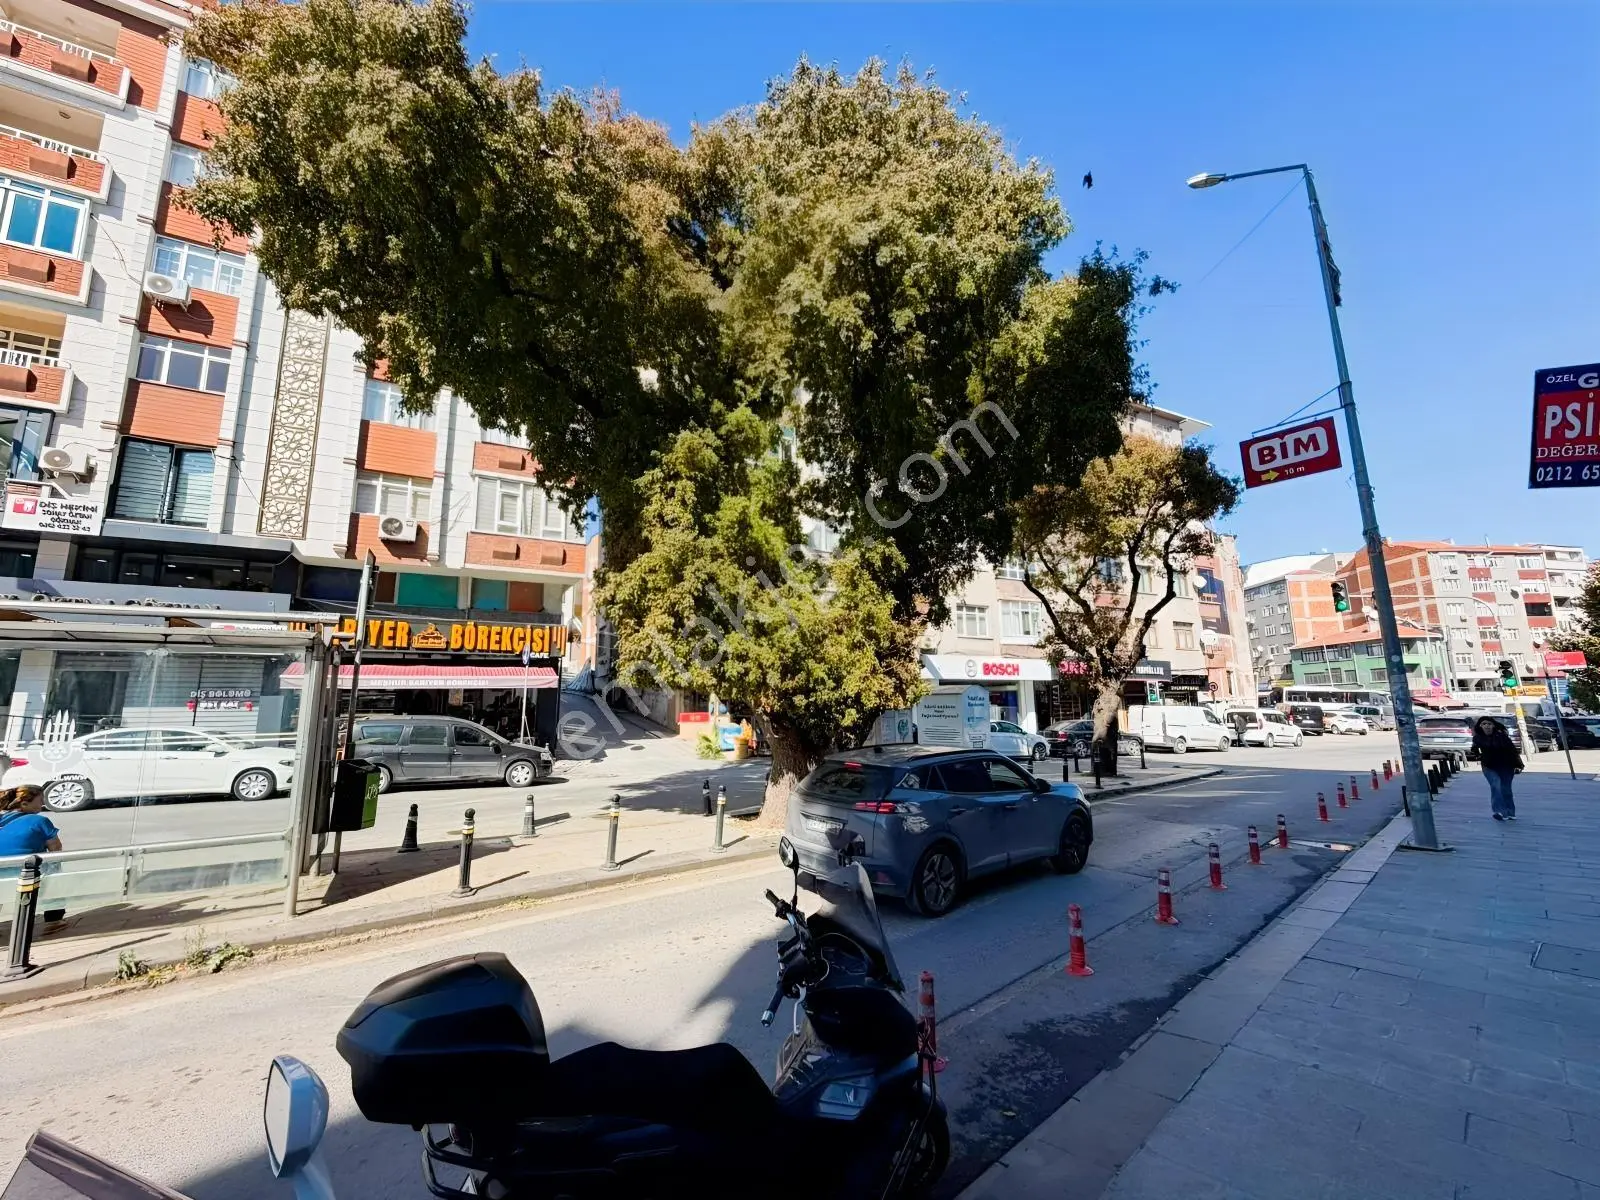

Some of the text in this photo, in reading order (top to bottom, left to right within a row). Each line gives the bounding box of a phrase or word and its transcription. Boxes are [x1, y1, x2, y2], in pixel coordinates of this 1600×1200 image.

[1546, 373, 1577, 383] ÖZEL
[1544, 391, 1600, 440] PSİ
[1284, 468, 1295, 476] 10
[1536, 465, 1573, 482] 0212
[450, 621, 550, 655] BÖREKÇİSİ
[983, 662, 1020, 677] BOSCH
